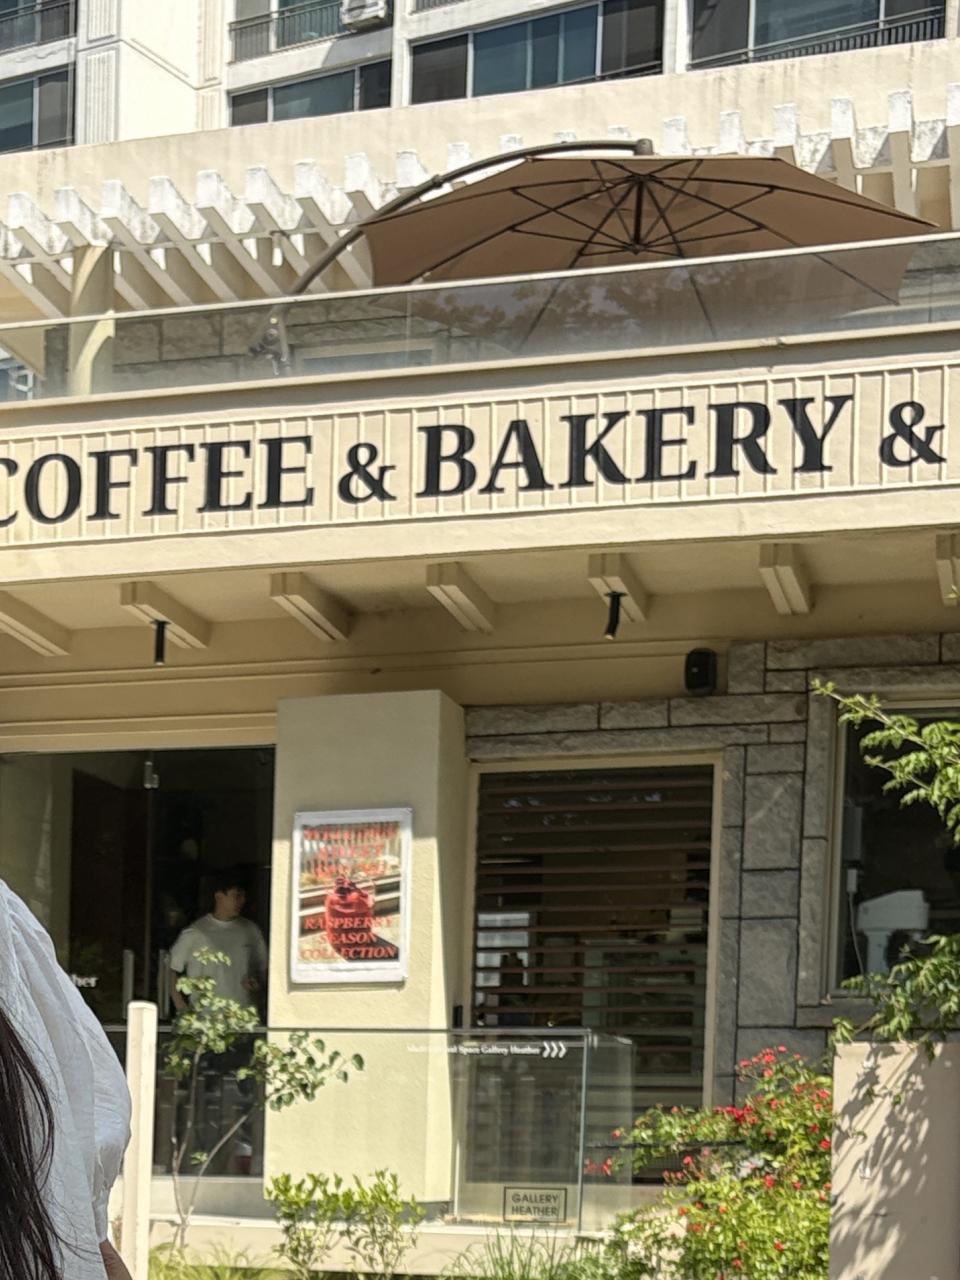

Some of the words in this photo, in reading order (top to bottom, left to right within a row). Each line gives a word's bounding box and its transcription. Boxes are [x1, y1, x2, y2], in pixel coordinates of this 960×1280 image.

[337, 442, 397, 502] &
[416, 395, 853, 499] BAKERY
[878, 400, 948, 468] &
[318, 932, 380, 944] SEASON
[299, 946, 396, 961] COLLECTION
[511, 1193, 559, 1203] GALLERY
[511, 1206, 559, 1216] HEATHER
